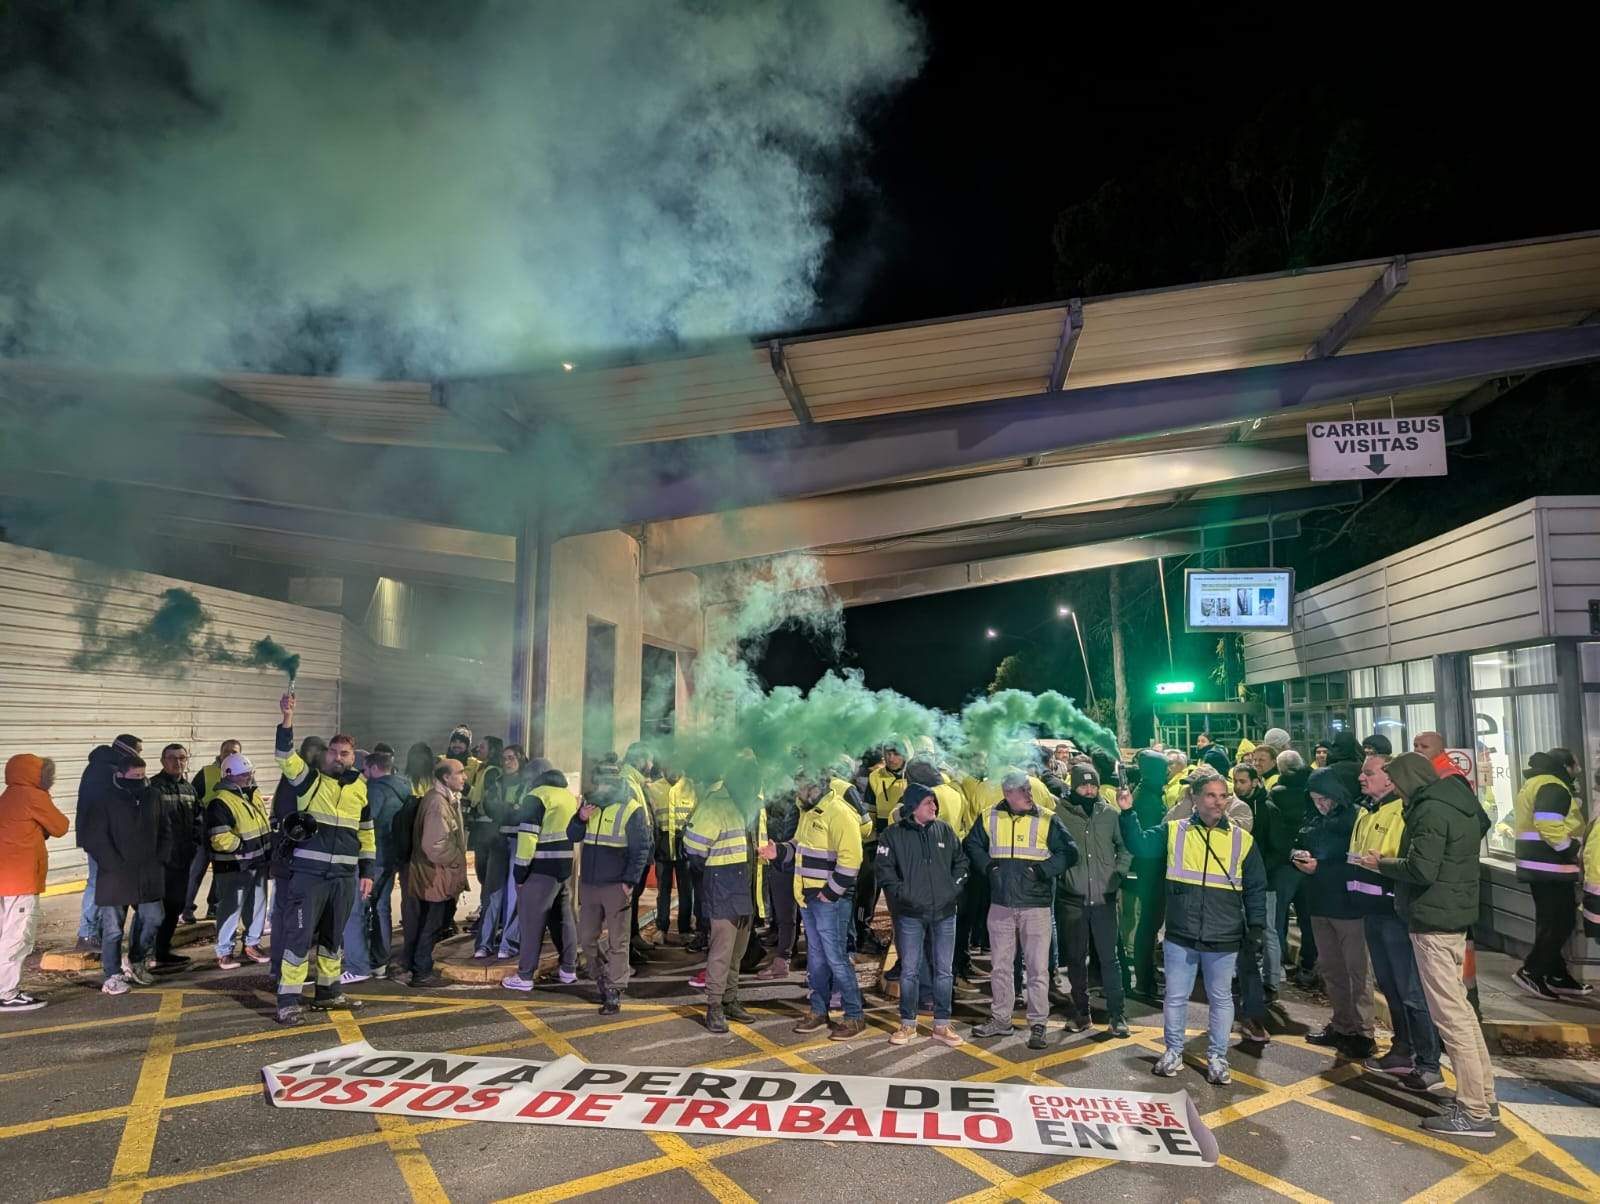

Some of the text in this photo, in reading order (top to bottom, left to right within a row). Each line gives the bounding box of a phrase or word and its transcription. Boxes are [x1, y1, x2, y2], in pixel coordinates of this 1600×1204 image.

[1311, 418, 1441, 438] CARRIL BUS
[1334, 437, 1419, 454] VISITAS
[483, 1064, 541, 1085] A
[562, 1067, 853, 1106] PERDA
[885, 1084, 1000, 1114] DE
[1028, 1094, 1176, 1115] COMITÉ DE
[515, 1091, 622, 1122] DE
[641, 1096, 1013, 1144] TRABALLO
[1031, 1106, 1184, 1129] EMPRESA
[1035, 1119, 1202, 1157] ENCE
